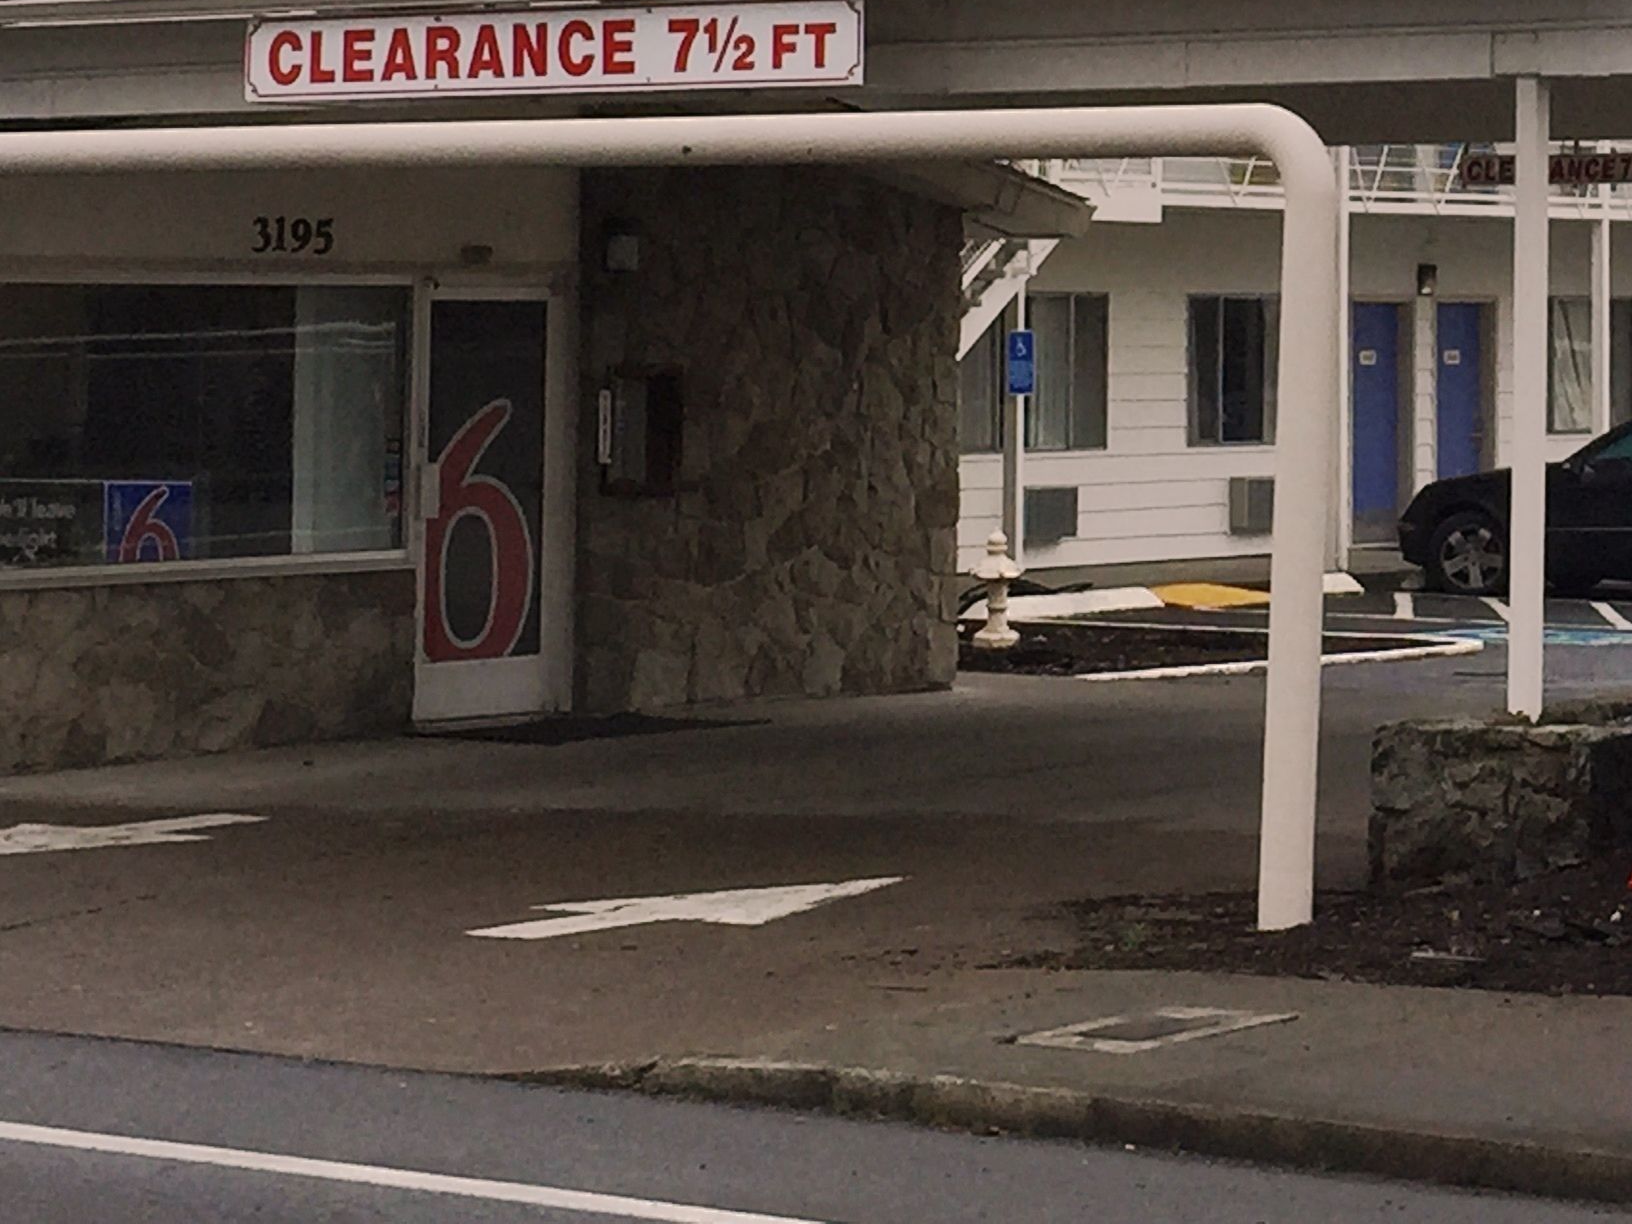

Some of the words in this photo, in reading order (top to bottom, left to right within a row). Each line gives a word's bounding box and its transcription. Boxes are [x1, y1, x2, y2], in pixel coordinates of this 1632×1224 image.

[267, 17, 636, 86] CLEARANCE
[771, 21, 838, 70] FT
[1466, 155, 1616, 182] CLEANCE
[251, 215, 335, 255] 3195
[423, 398, 534, 664] 6
